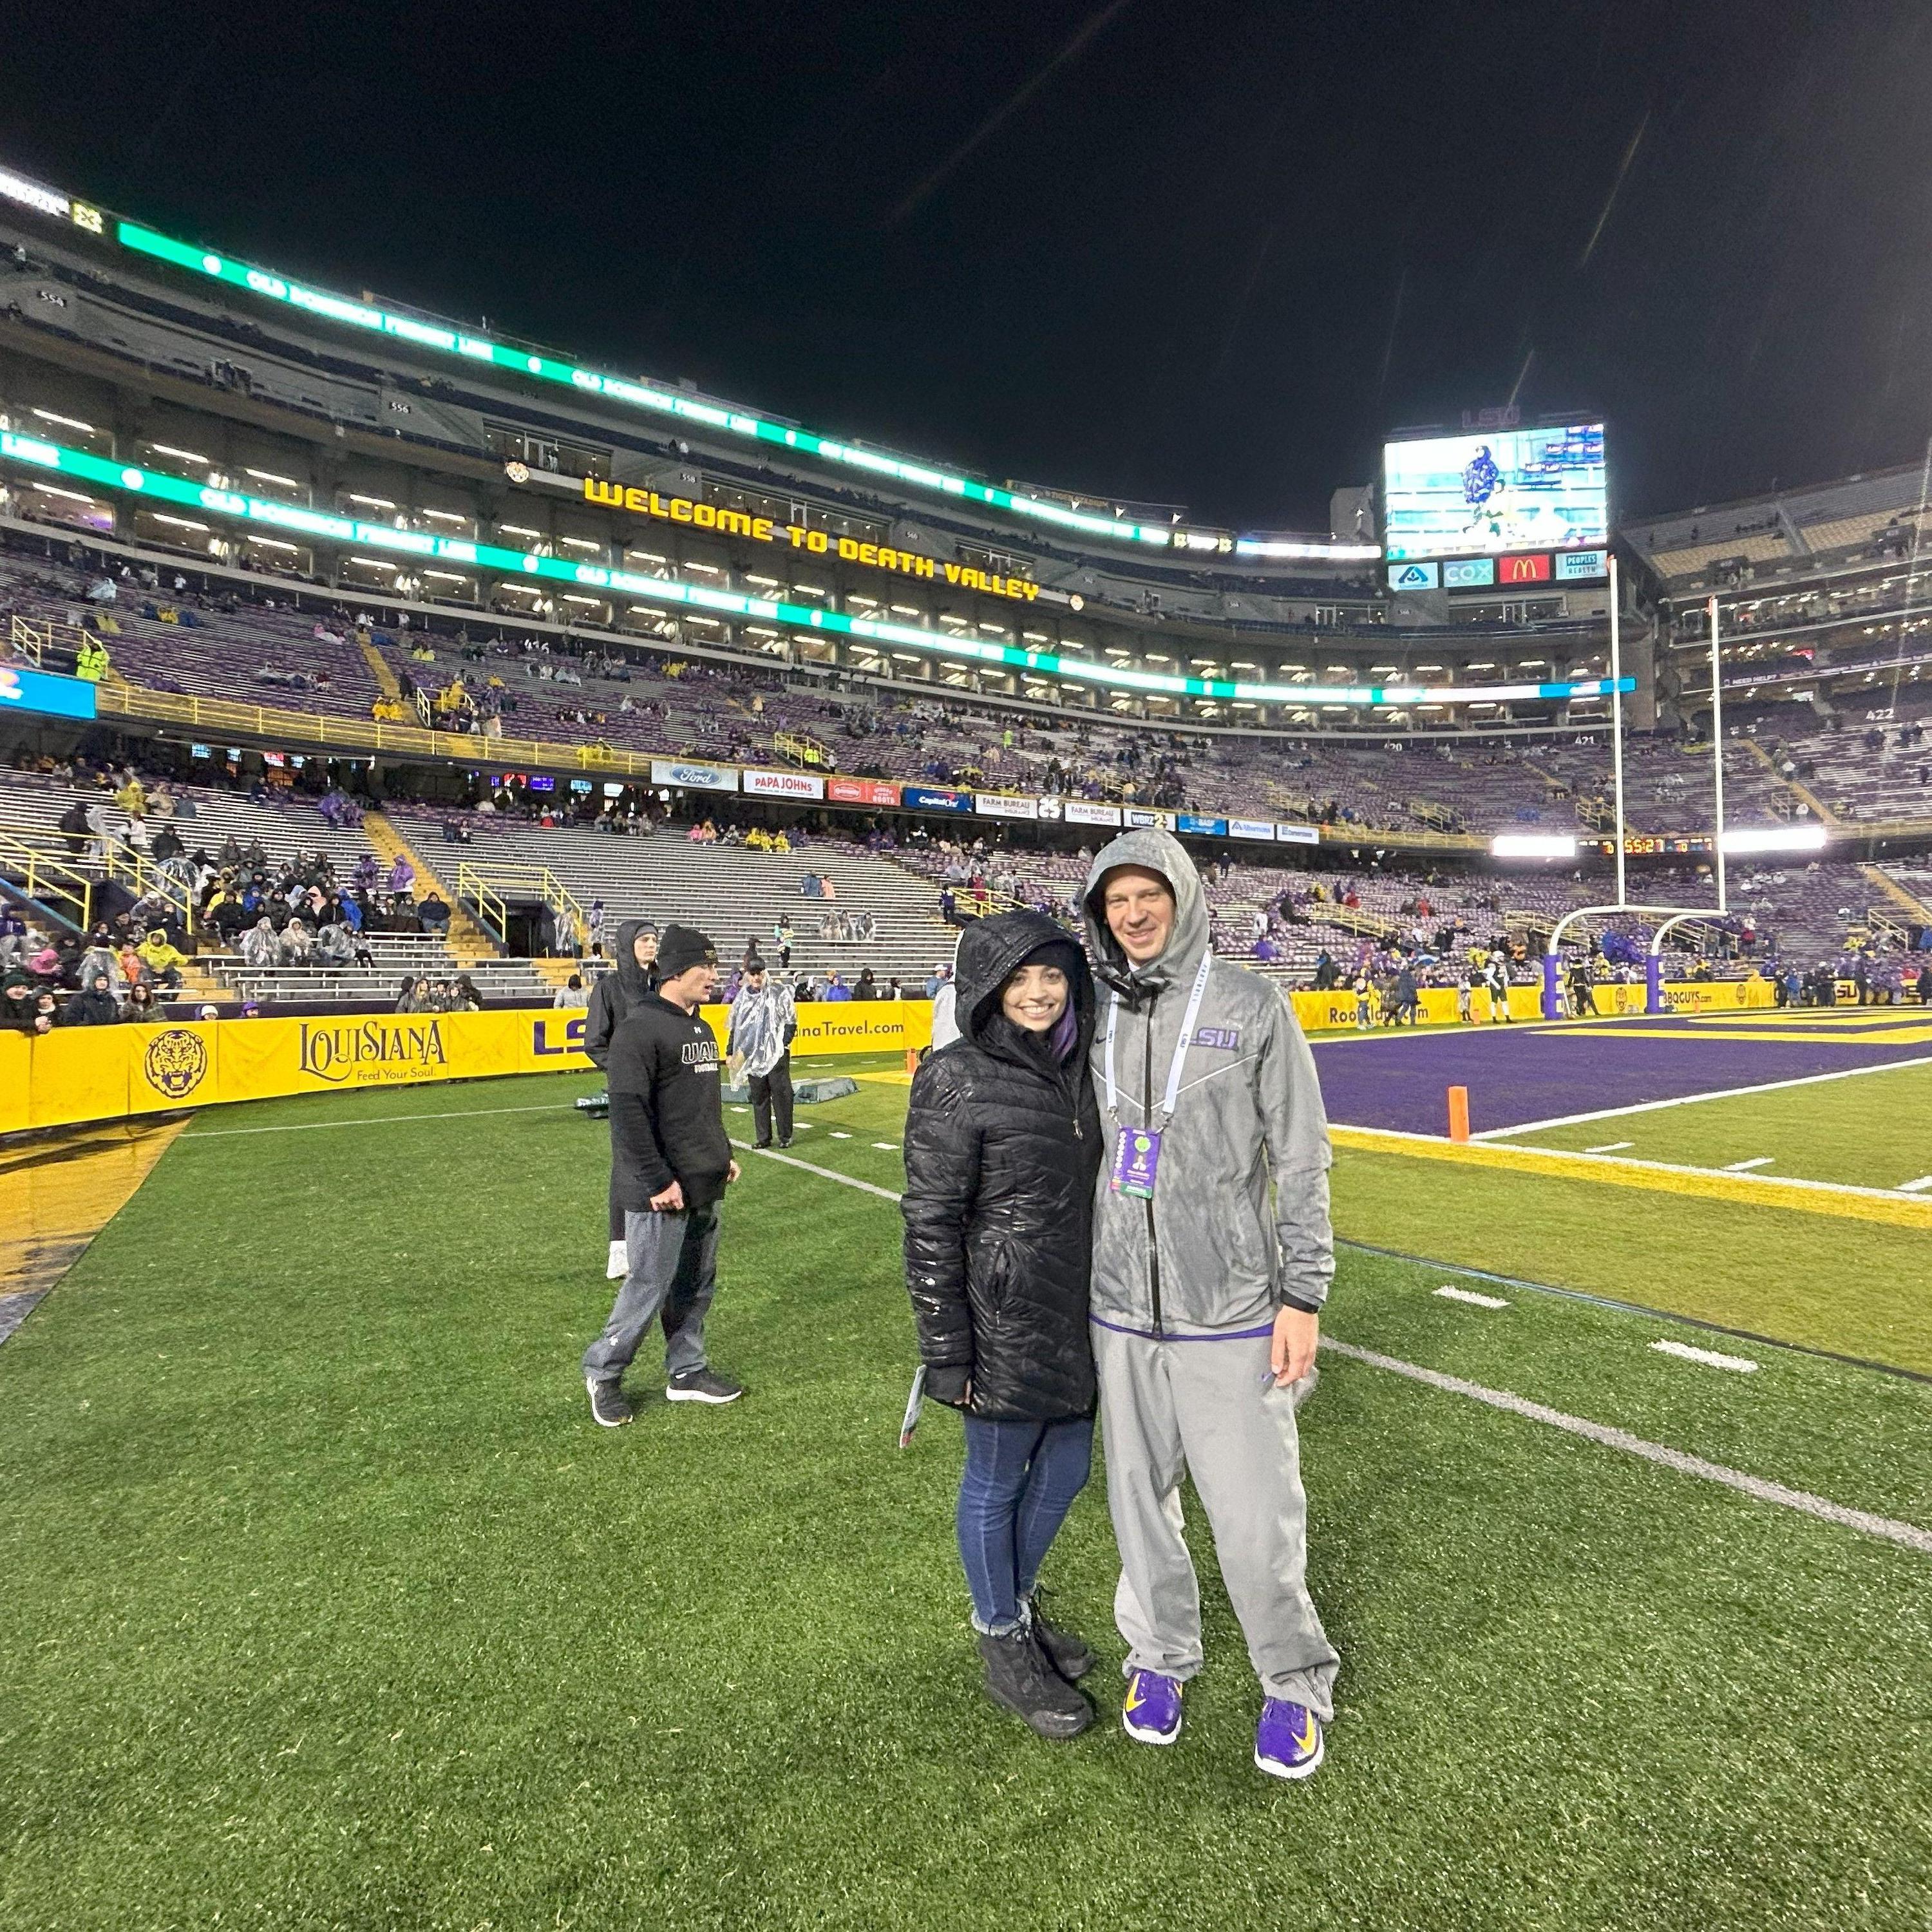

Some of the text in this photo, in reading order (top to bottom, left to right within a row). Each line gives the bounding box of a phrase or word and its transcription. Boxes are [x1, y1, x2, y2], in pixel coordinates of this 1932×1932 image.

[392, 402, 408, 413] 556
[584, 478, 1039, 601] WELCOME TO DEATH VALLEY
[1446, 563, 1490, 582] COX
[1866, 707, 1894, 721] 422
[1575, 735, 1594, 745] 421
[679, 768, 712, 784] Ford
[755, 777, 813, 791] PAPA JOHNS
[983, 797, 1030, 808] FARM BUREAU
[1072, 806, 1113, 817] FARM BUREAU
[1132, 813, 1154, 825] WBRZ
[534, 1019, 587, 1055] LS
[298, 1020, 449, 1082] LOUISIANA
[357, 1070, 380, 1081] Feed
[384, 1068, 408, 1079] Your
